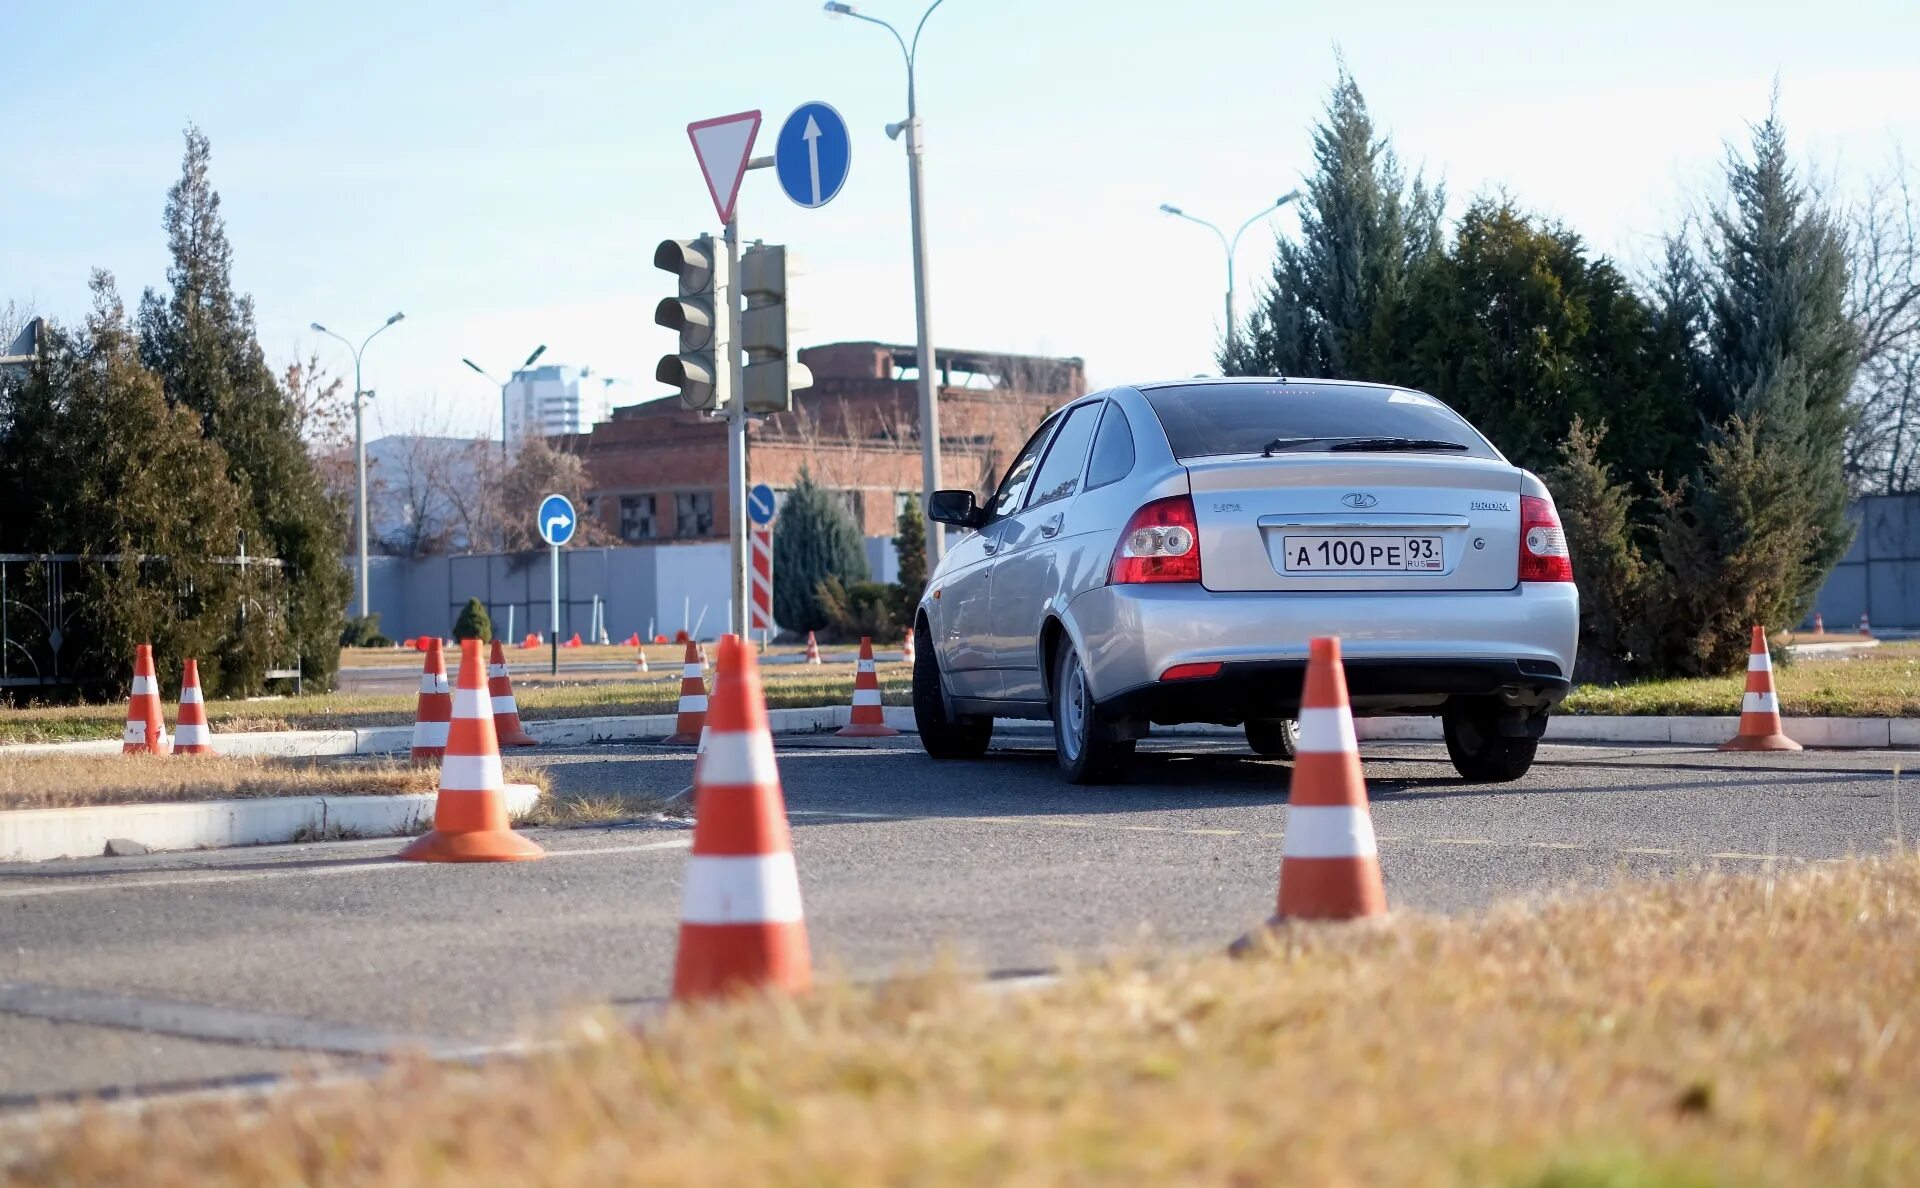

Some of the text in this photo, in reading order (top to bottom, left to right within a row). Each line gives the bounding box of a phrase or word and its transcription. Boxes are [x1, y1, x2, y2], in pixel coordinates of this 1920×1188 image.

[1470, 501, 1511, 511] PRIORA
[1408, 539, 1433, 559] 93
[1407, 560, 1426, 568] RUS
